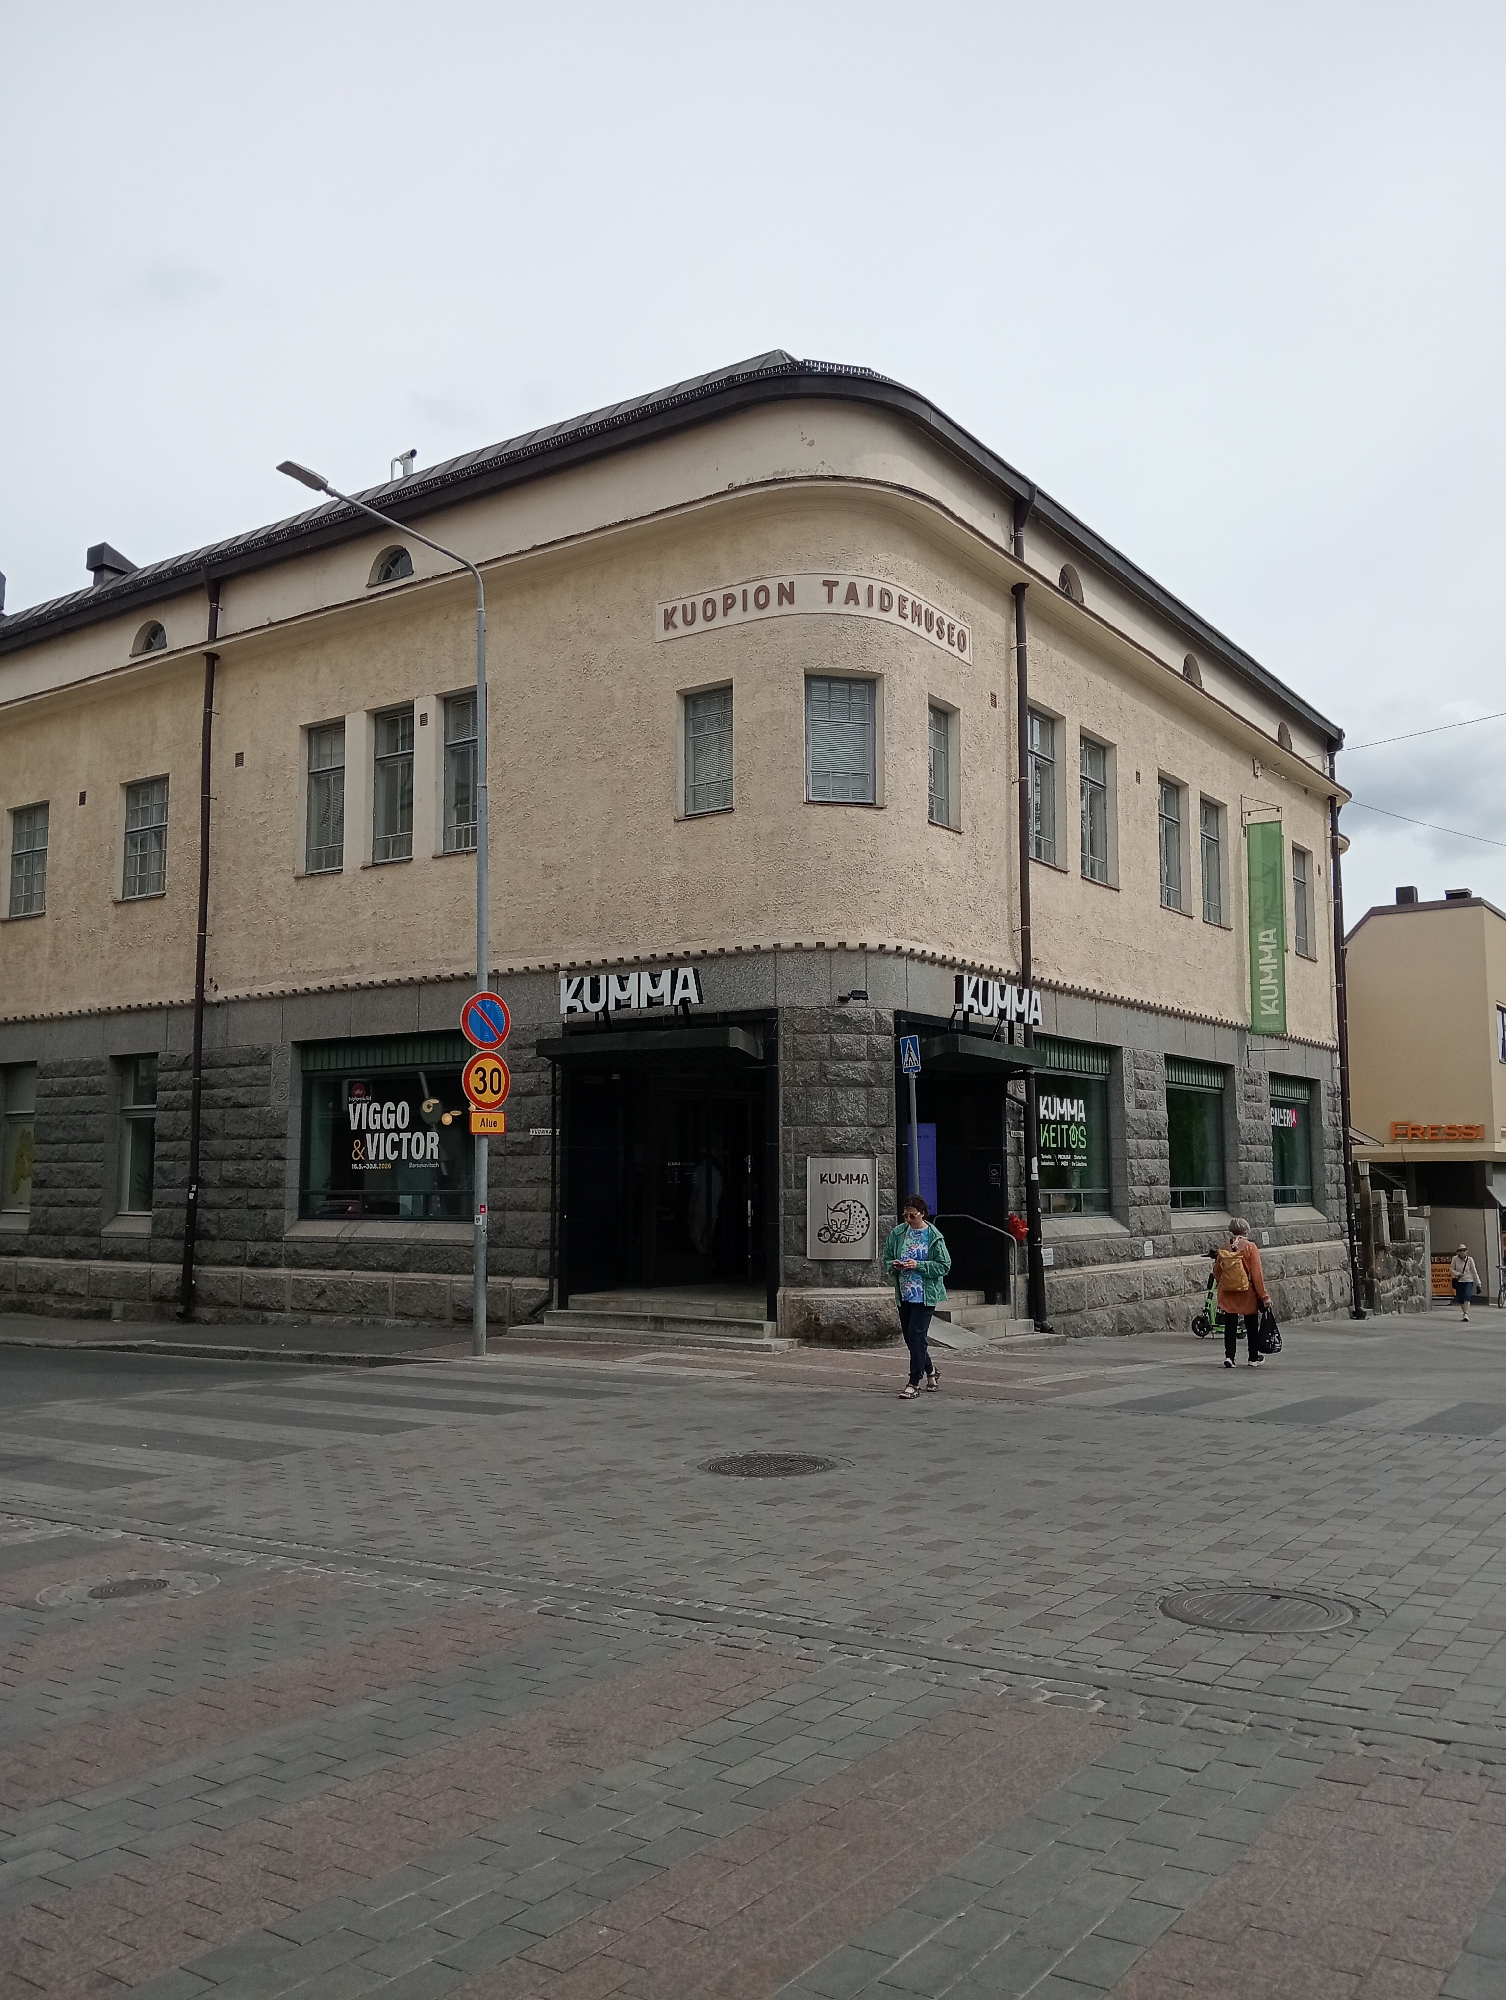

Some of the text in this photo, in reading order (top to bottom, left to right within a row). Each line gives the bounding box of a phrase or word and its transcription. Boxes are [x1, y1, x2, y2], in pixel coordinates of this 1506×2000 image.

[663, 579, 968, 654] KUOPION TAIDEMUSEO
[1258, 927, 1280, 1016] KUMMA
[560, 967, 700, 1015] KUMMA
[963, 974, 1043, 1026] KUMMA
[474, 1066, 502, 1095] 30
[348, 1101, 410, 1130] VIGGO
[479, 1118, 498, 1128] Alue
[1039, 1095, 1086, 1123] KUMMA
[1040, 1123, 1087, 1149] KEITOS
[1390, 1121, 1485, 1141] FRESSI
[819, 1173, 870, 1185] KUMMA
